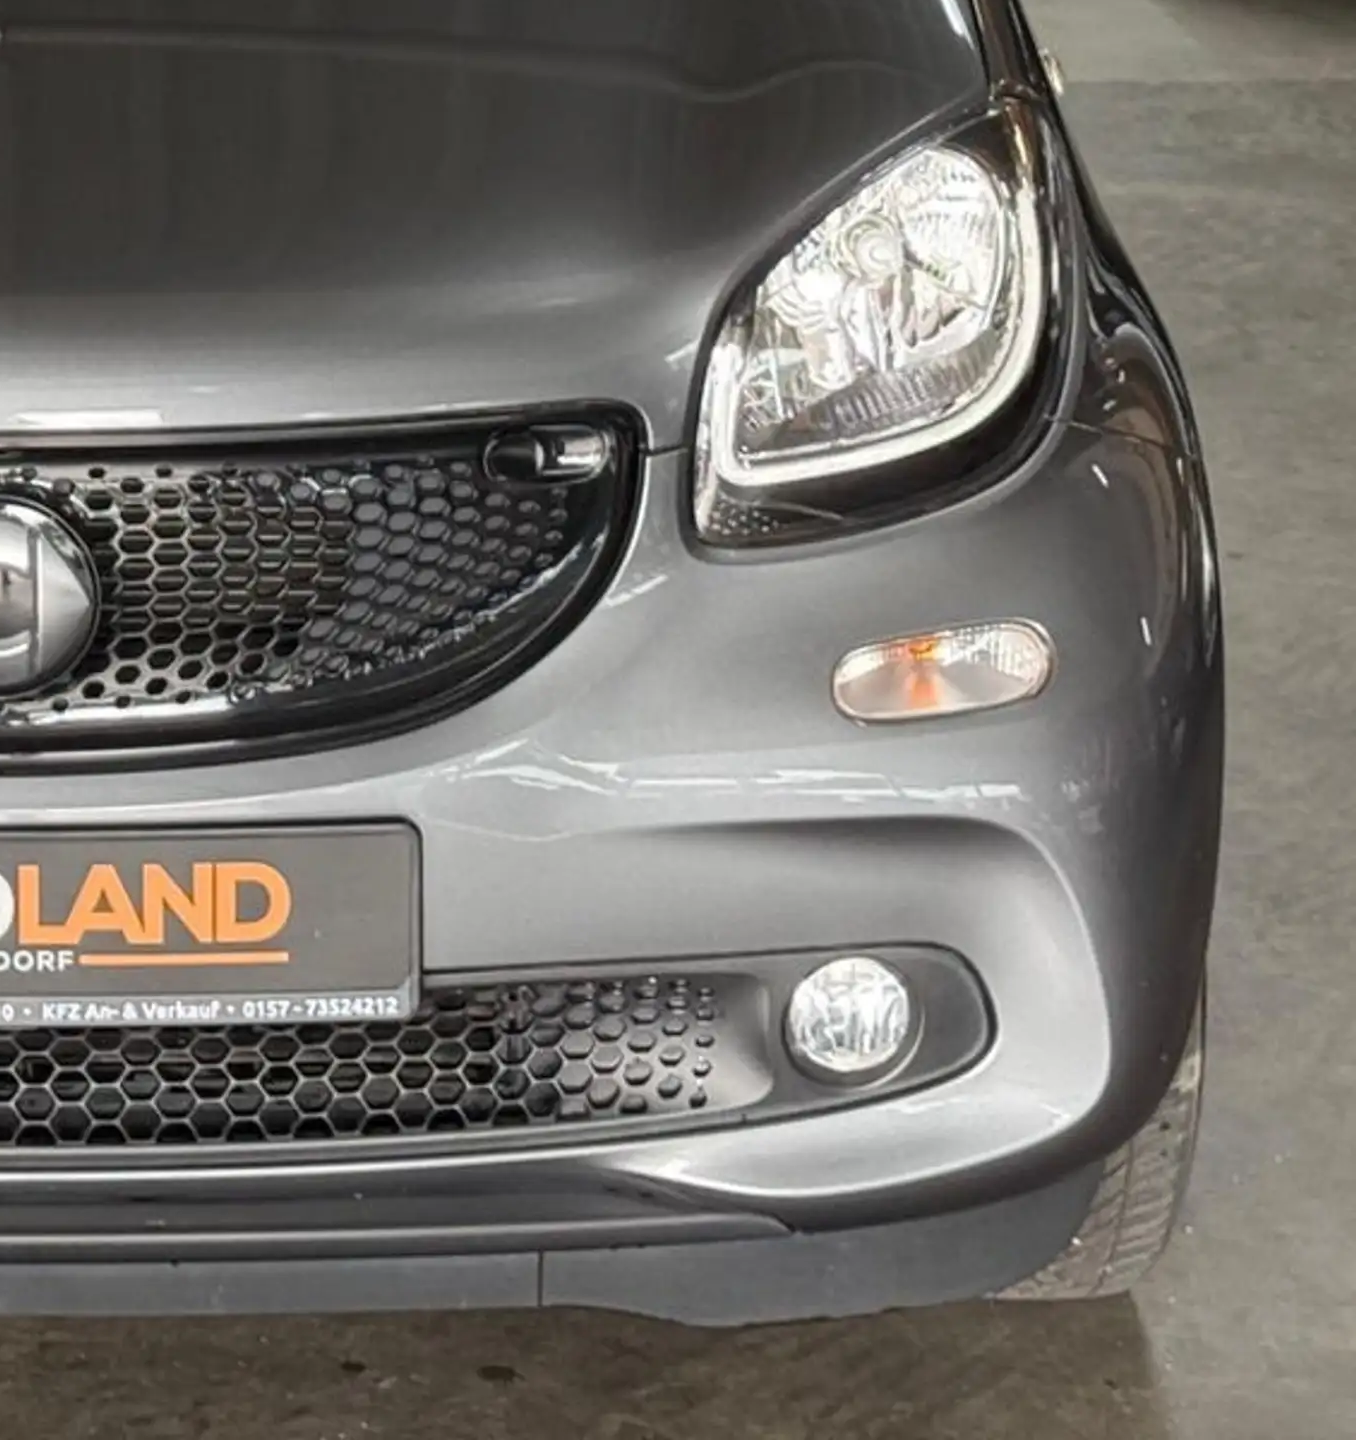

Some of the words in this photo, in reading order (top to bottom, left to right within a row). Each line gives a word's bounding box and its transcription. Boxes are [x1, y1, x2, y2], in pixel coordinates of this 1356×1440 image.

[42, 1002, 82, 1022] KFZ
[121, 1002, 138, 1020] &
[143, 998, 221, 1021] Verkauf
